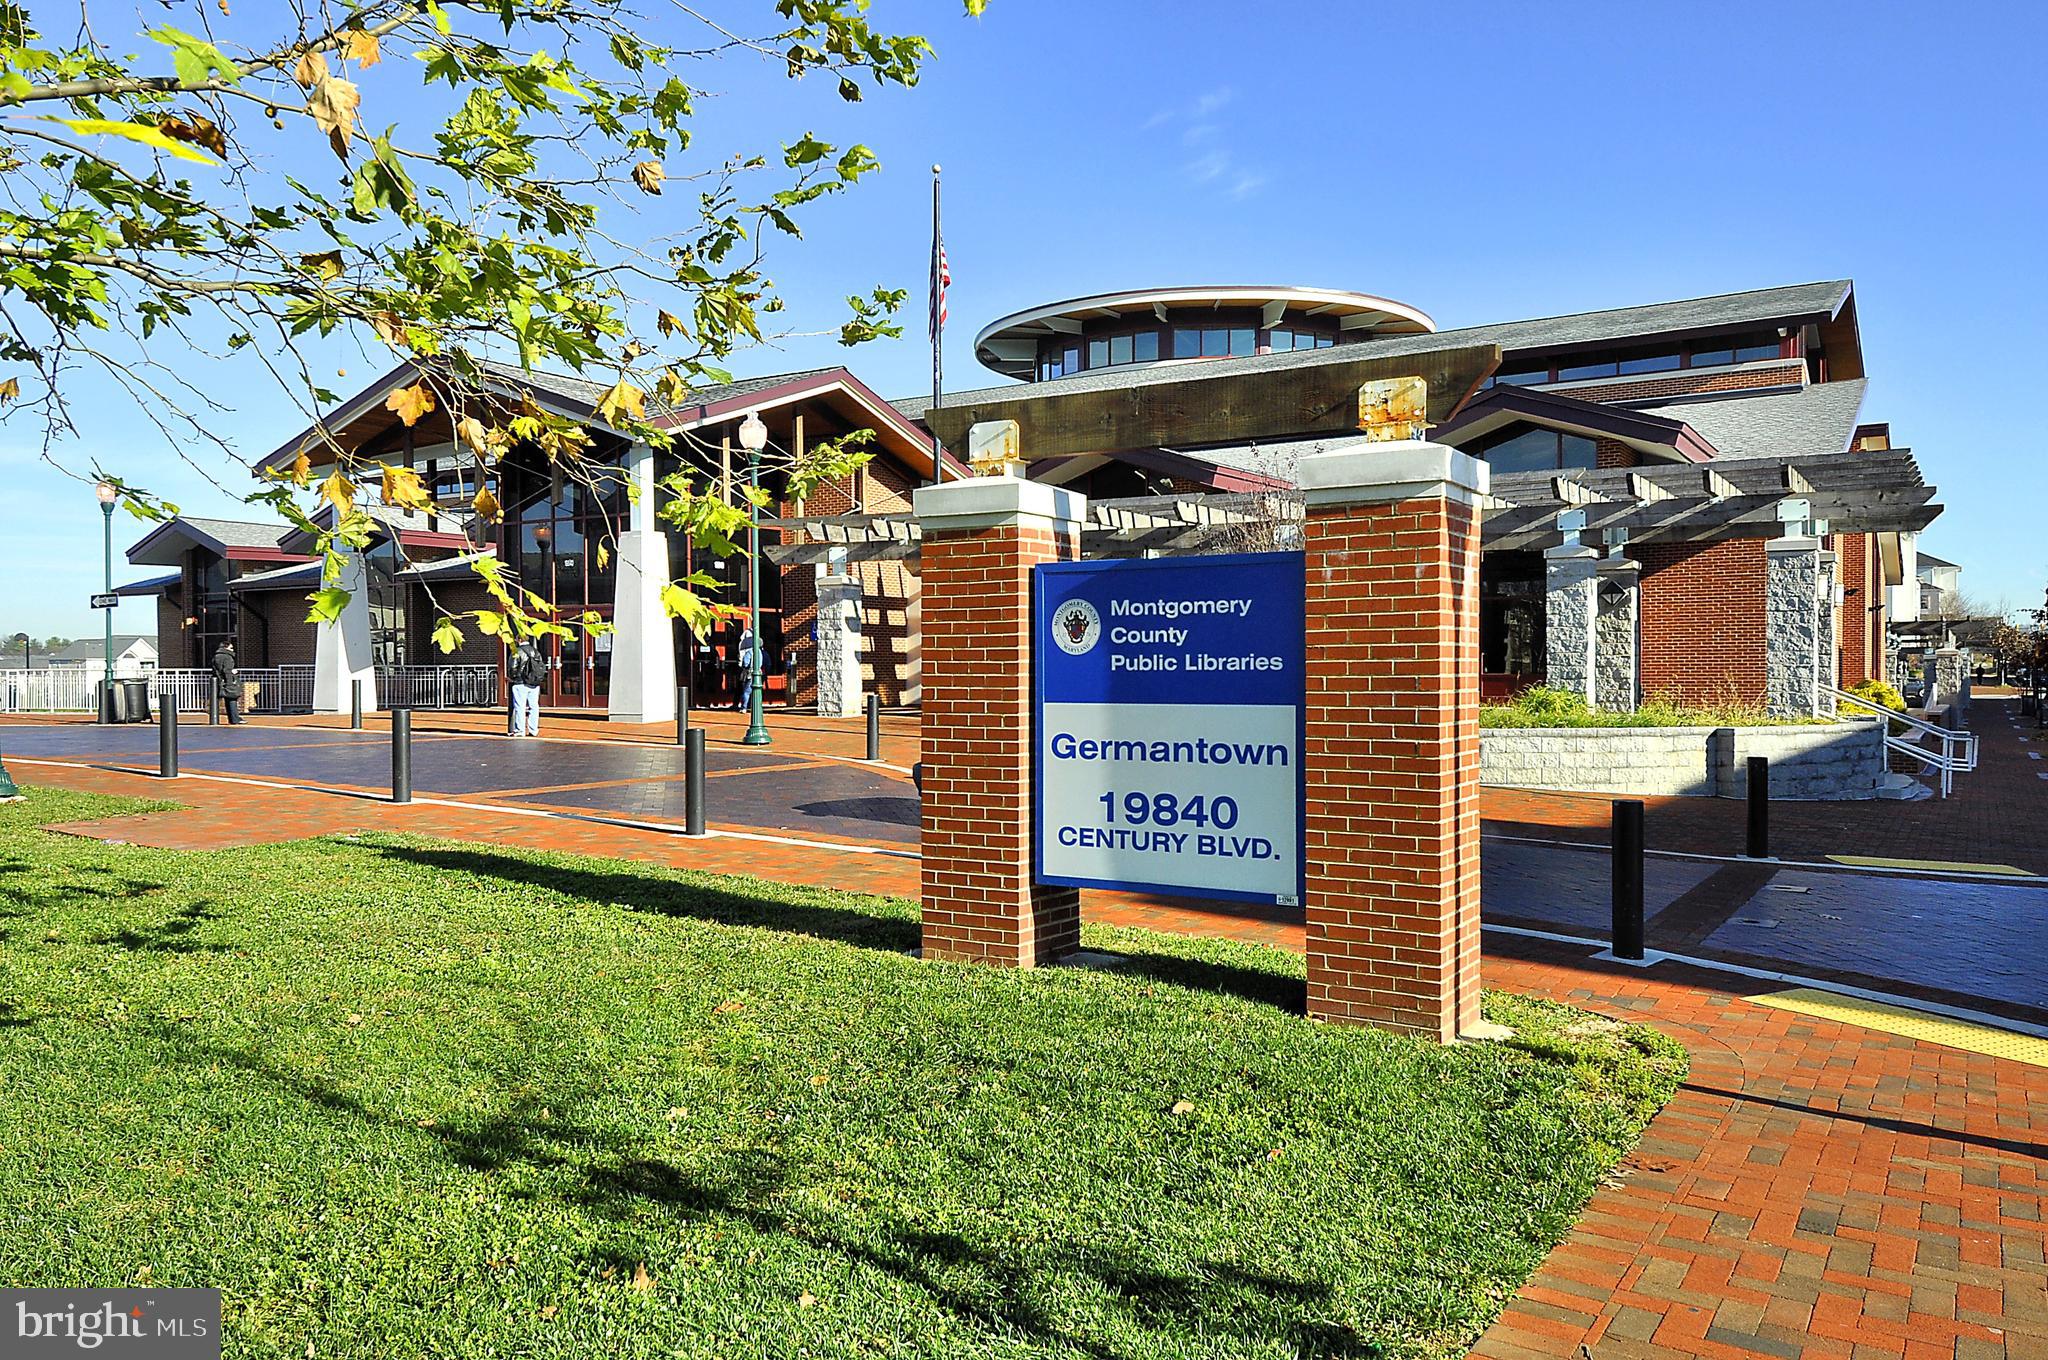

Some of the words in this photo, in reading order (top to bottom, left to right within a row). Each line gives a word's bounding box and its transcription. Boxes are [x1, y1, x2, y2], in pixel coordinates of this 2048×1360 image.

[1111, 599, 1252, 618] Montgomery
[1110, 626, 1188, 646] County
[1110, 654, 1178, 671] Public
[1185, 653, 1284, 671] Libraries
[1051, 733, 1288, 766] Germantown
[1100, 791, 1239, 830] 19840
[1058, 826, 1188, 853] CENTURY
[1197, 835, 1281, 860] BLVD.
